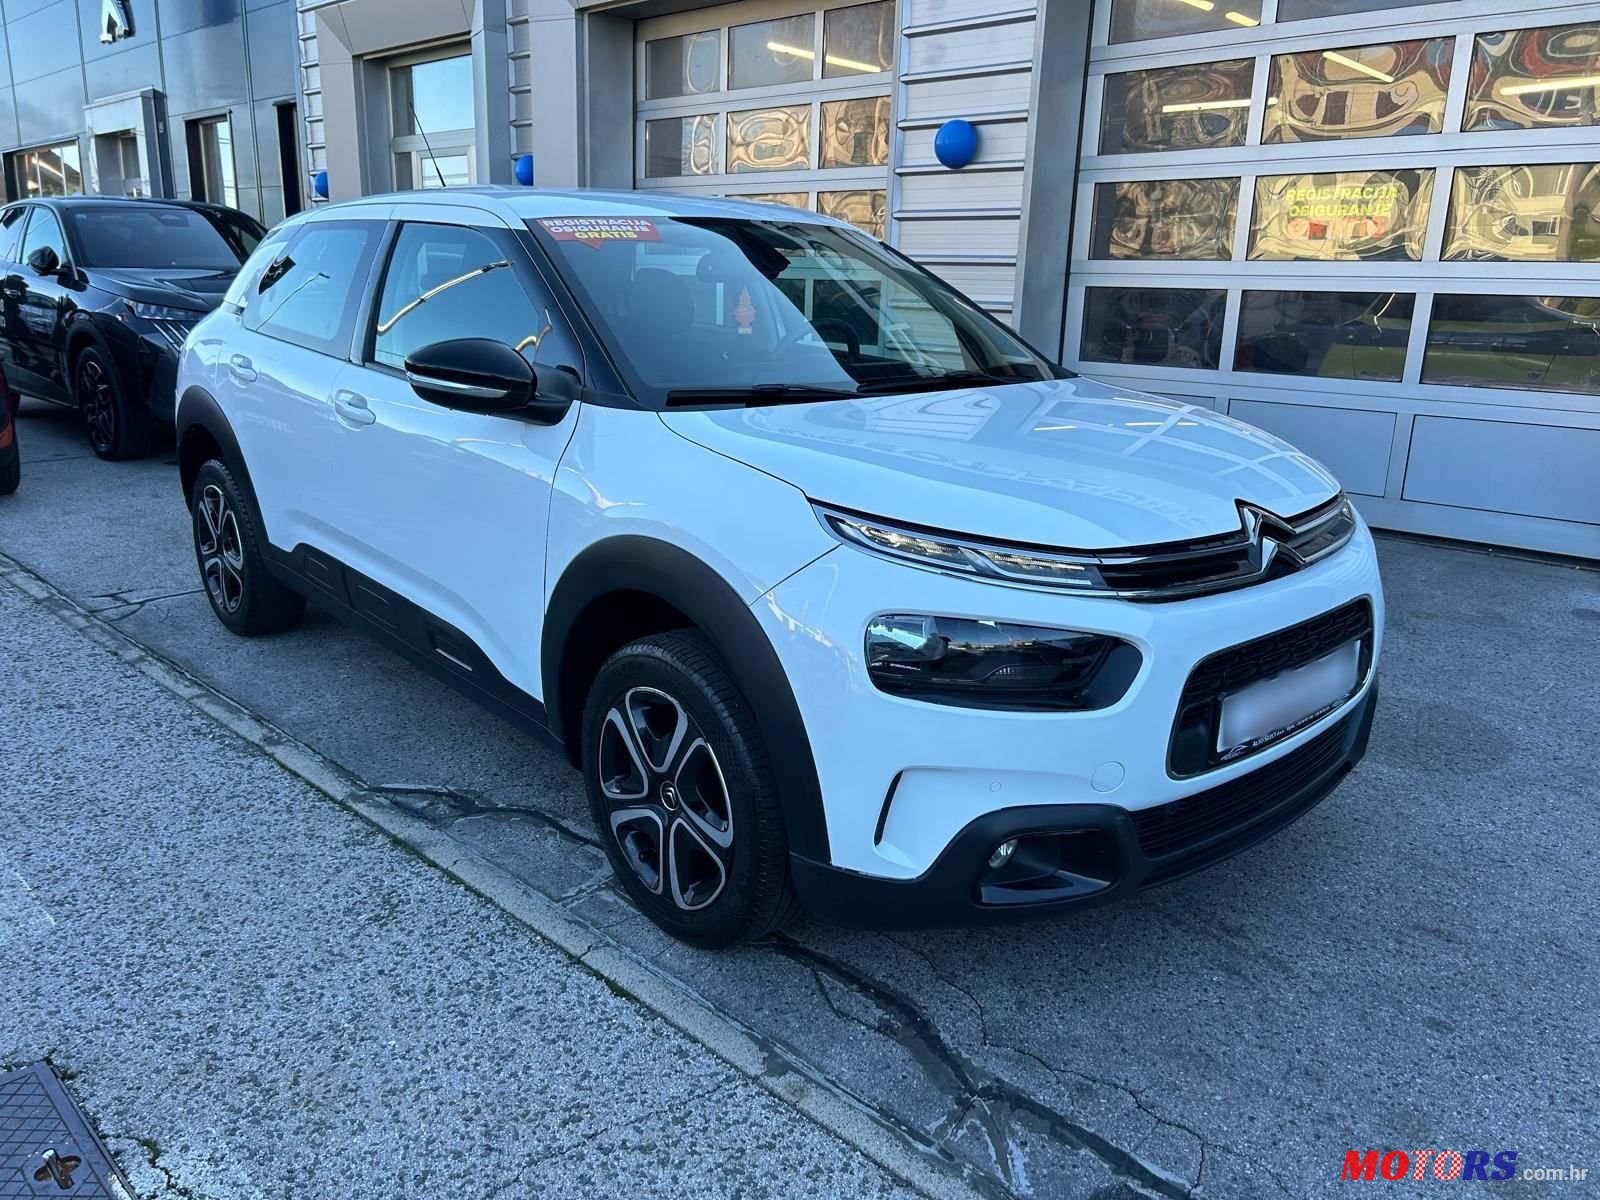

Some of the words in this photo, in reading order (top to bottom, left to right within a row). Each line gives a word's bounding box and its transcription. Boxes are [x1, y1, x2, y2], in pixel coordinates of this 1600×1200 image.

[542, 219, 652, 227] REGISTRACIJA
[550, 225, 650, 233] OSIGURANJE
[575, 231, 638, 239] GRATIS
